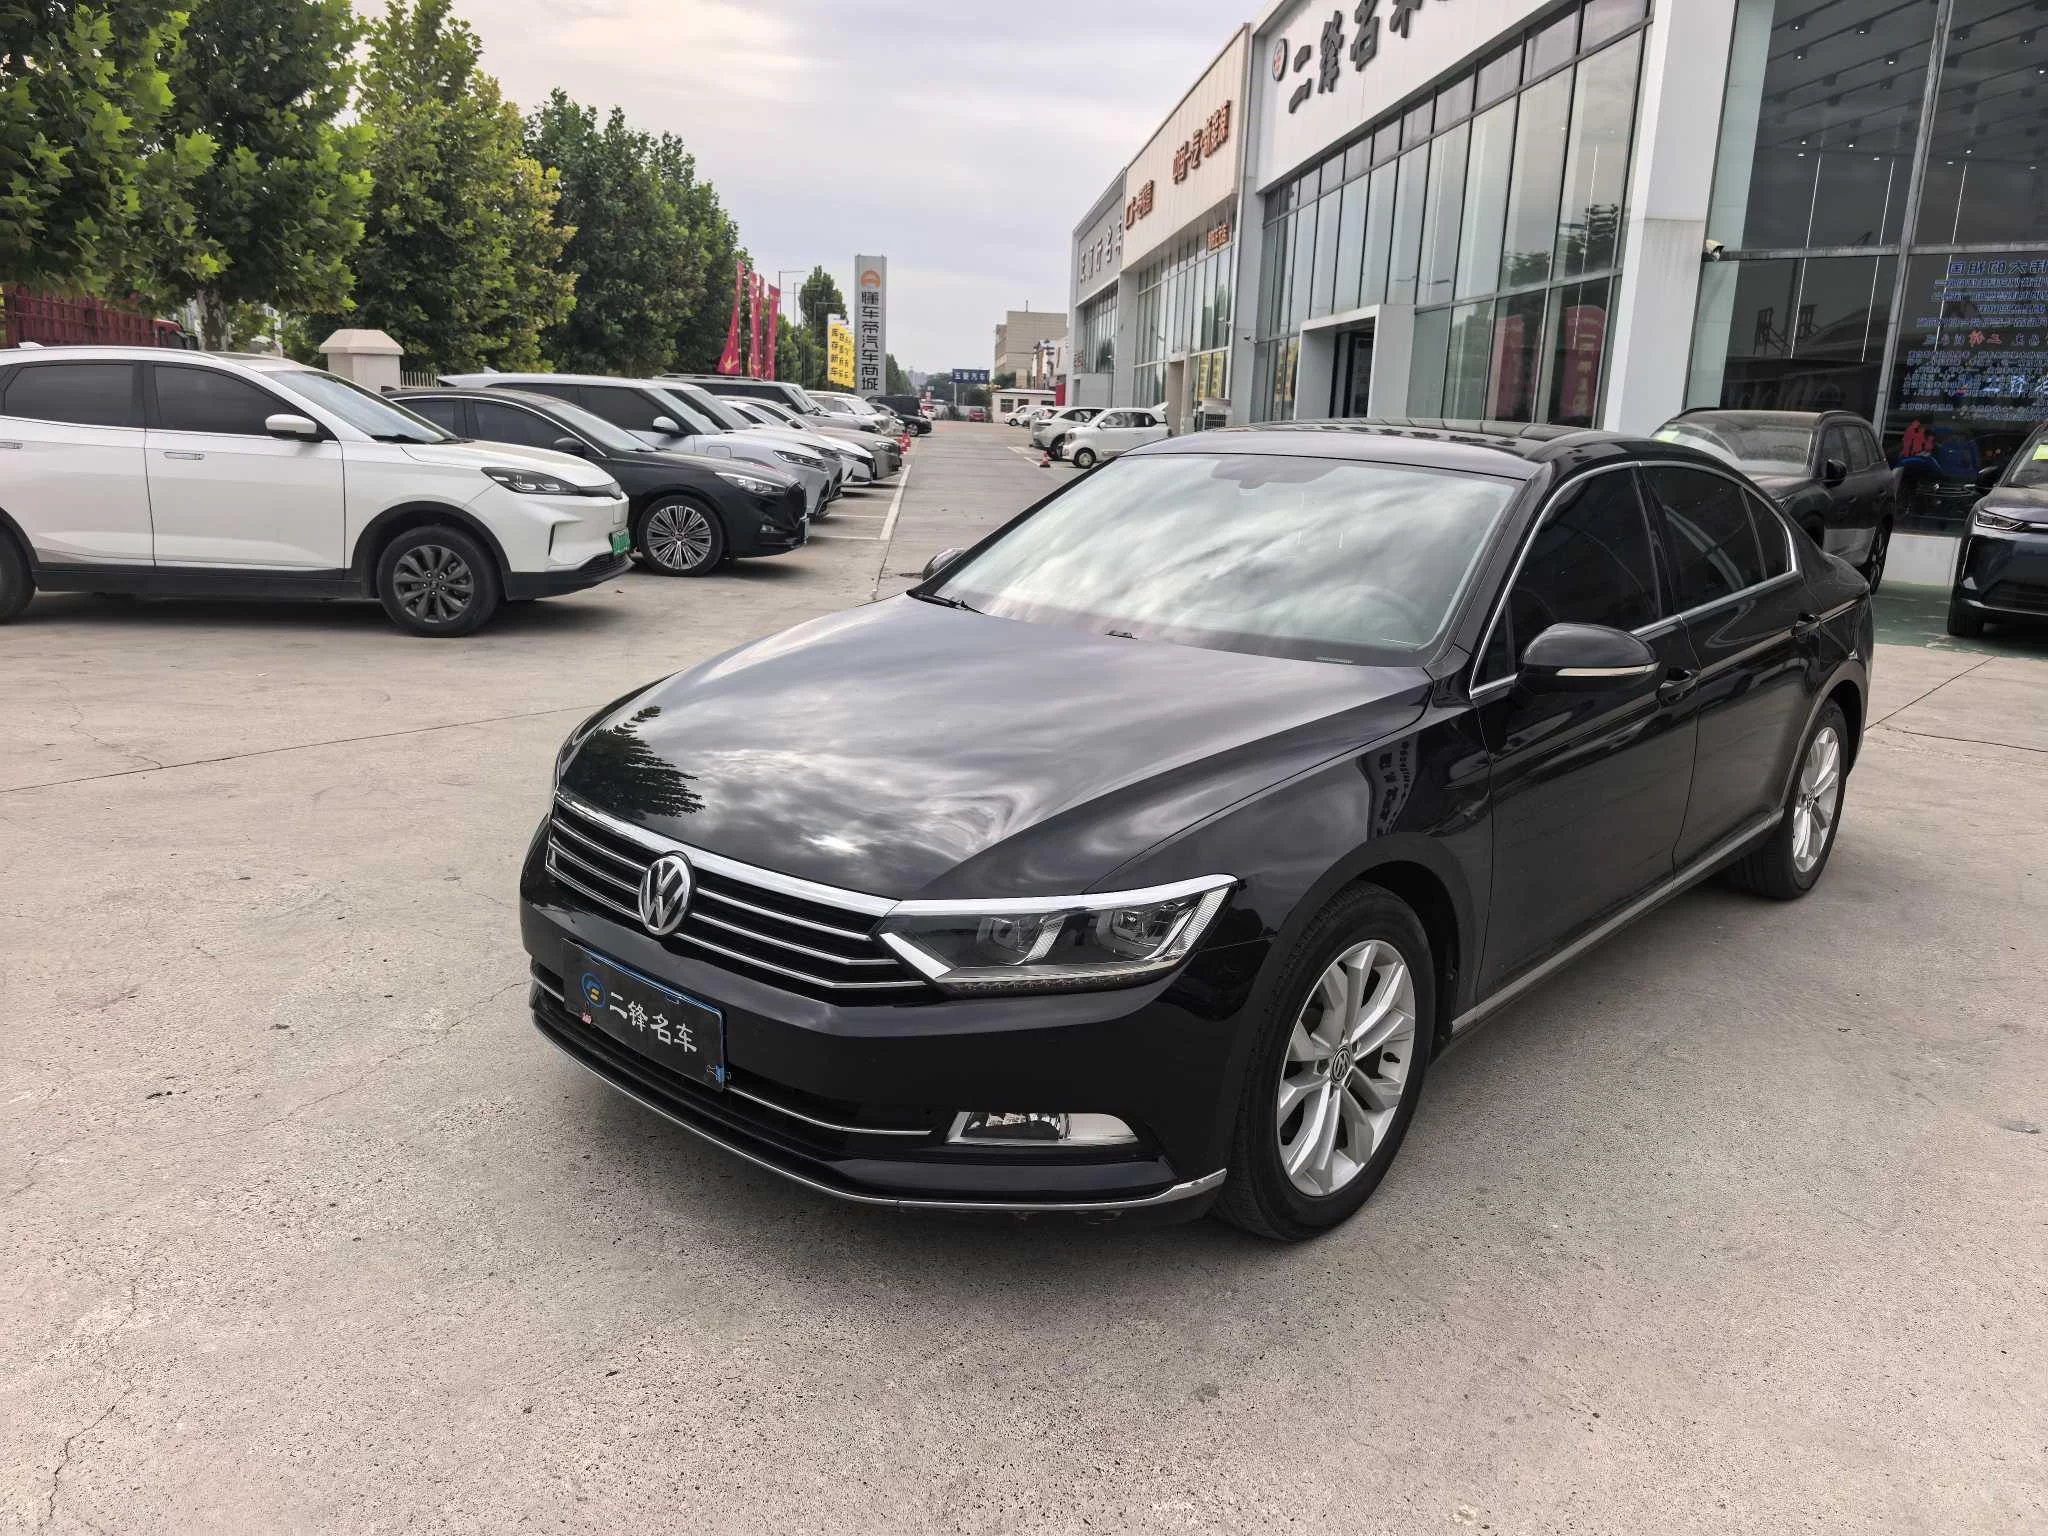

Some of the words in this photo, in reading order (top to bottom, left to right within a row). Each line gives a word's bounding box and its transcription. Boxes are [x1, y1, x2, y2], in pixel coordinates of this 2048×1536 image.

[861, 291, 880, 390] 懂车帝汽车商城
[609, 991, 698, 1053] 二锋名车
